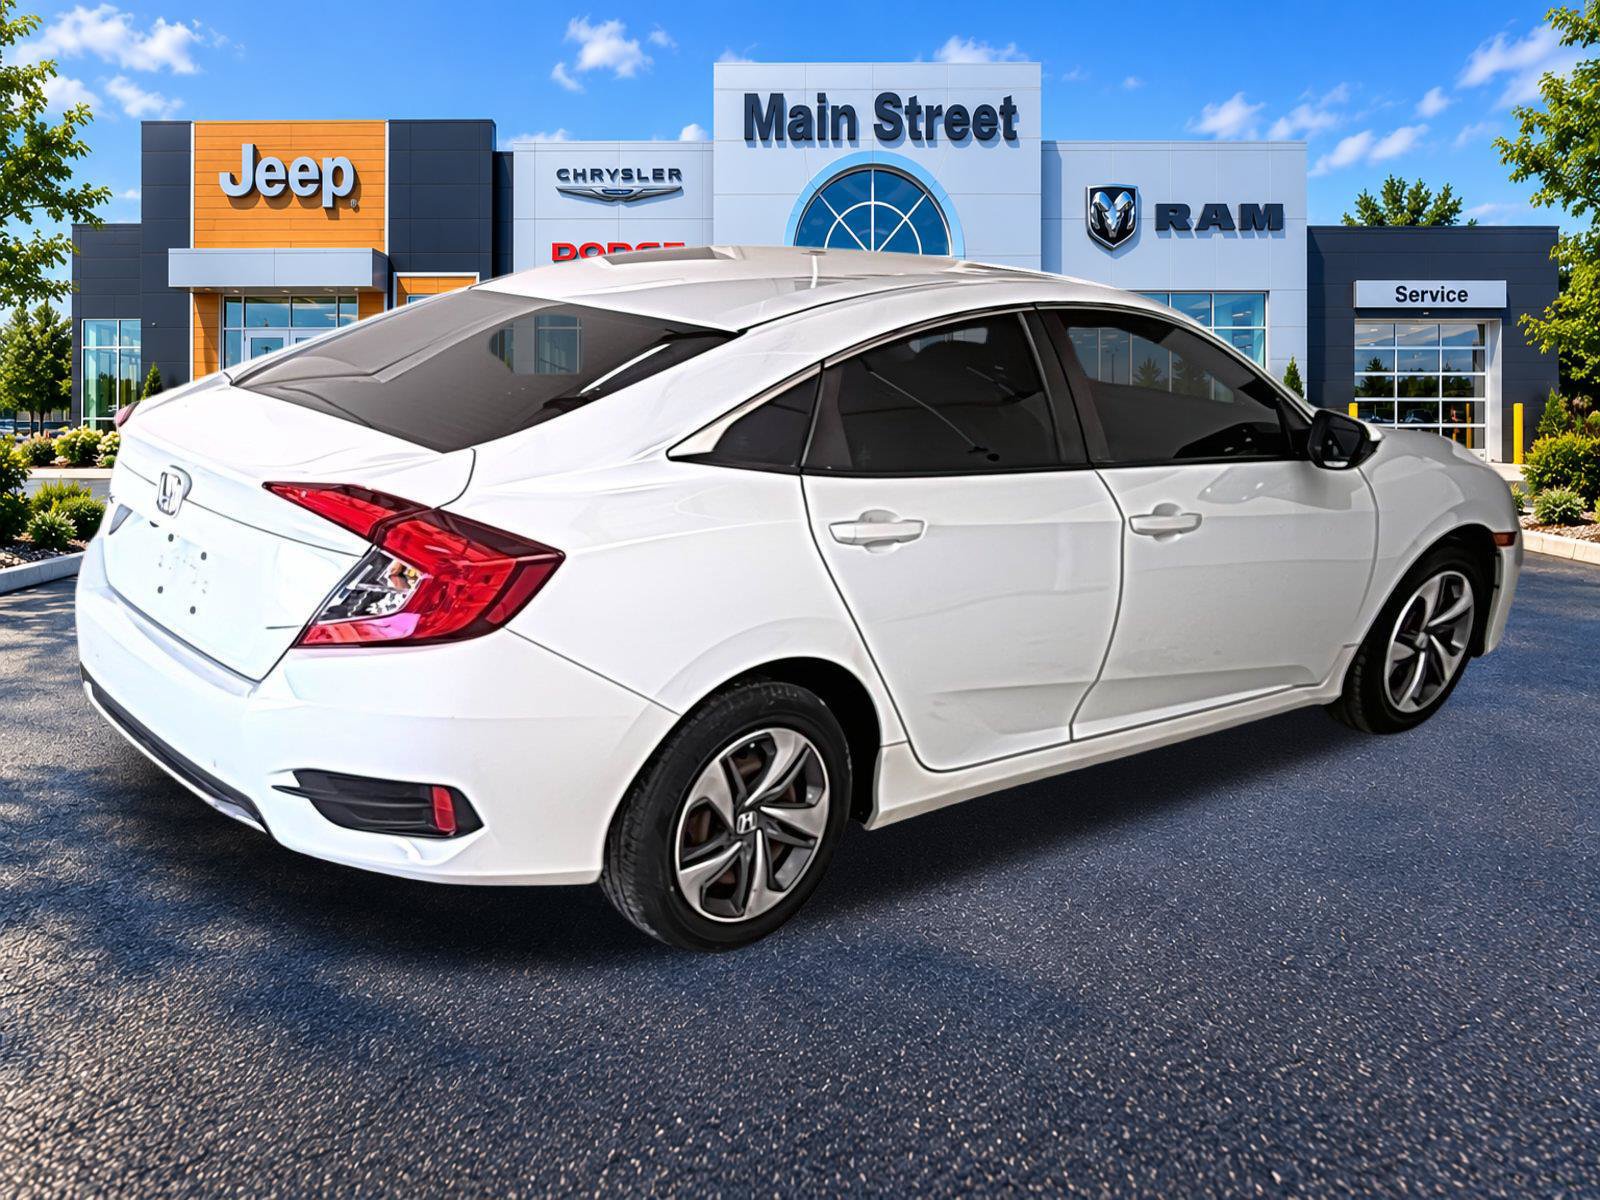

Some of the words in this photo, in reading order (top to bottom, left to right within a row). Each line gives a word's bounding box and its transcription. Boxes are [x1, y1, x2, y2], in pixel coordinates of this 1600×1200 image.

[743, 92, 857, 141] Main
[873, 91, 1017, 141] Street
[218, 143, 355, 208] Jeep
[556, 167, 682, 182] CHRYSLER
[1155, 203, 1284, 232] RAM
[1395, 285, 1468, 303] Service
